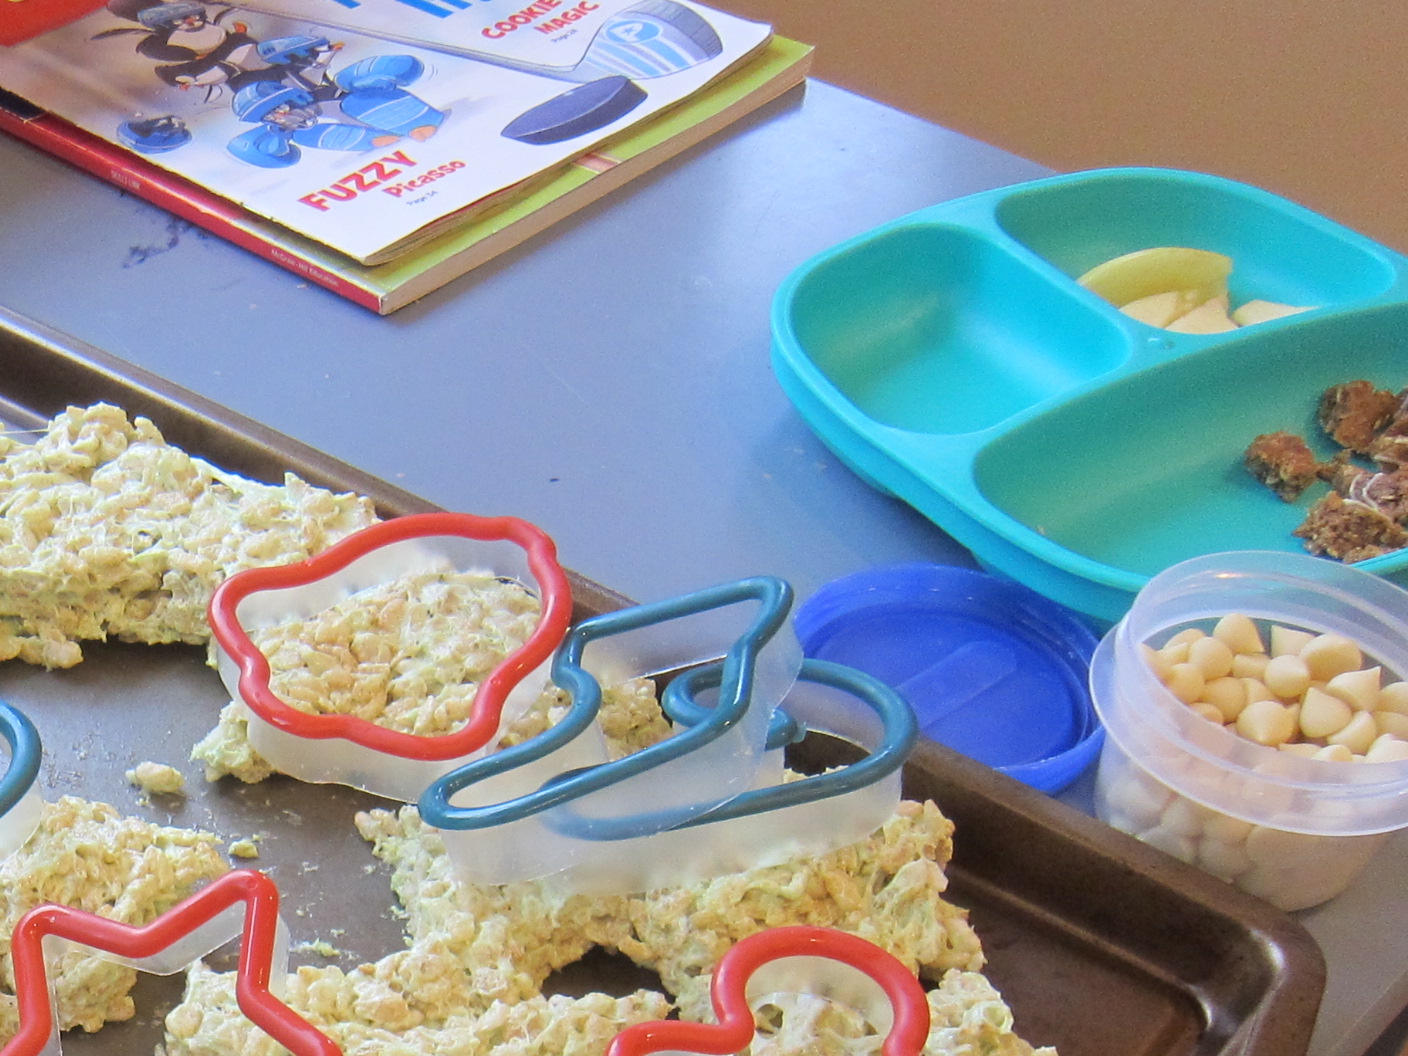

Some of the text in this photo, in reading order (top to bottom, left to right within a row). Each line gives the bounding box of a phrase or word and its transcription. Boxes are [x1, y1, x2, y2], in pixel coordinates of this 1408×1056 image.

[481, 0, 562, 39] COOKIE
[533, 0, 600, 35] MAGIC
[297, 150, 417, 212] FUZZY
[382, 161, 466, 198] Picasso
